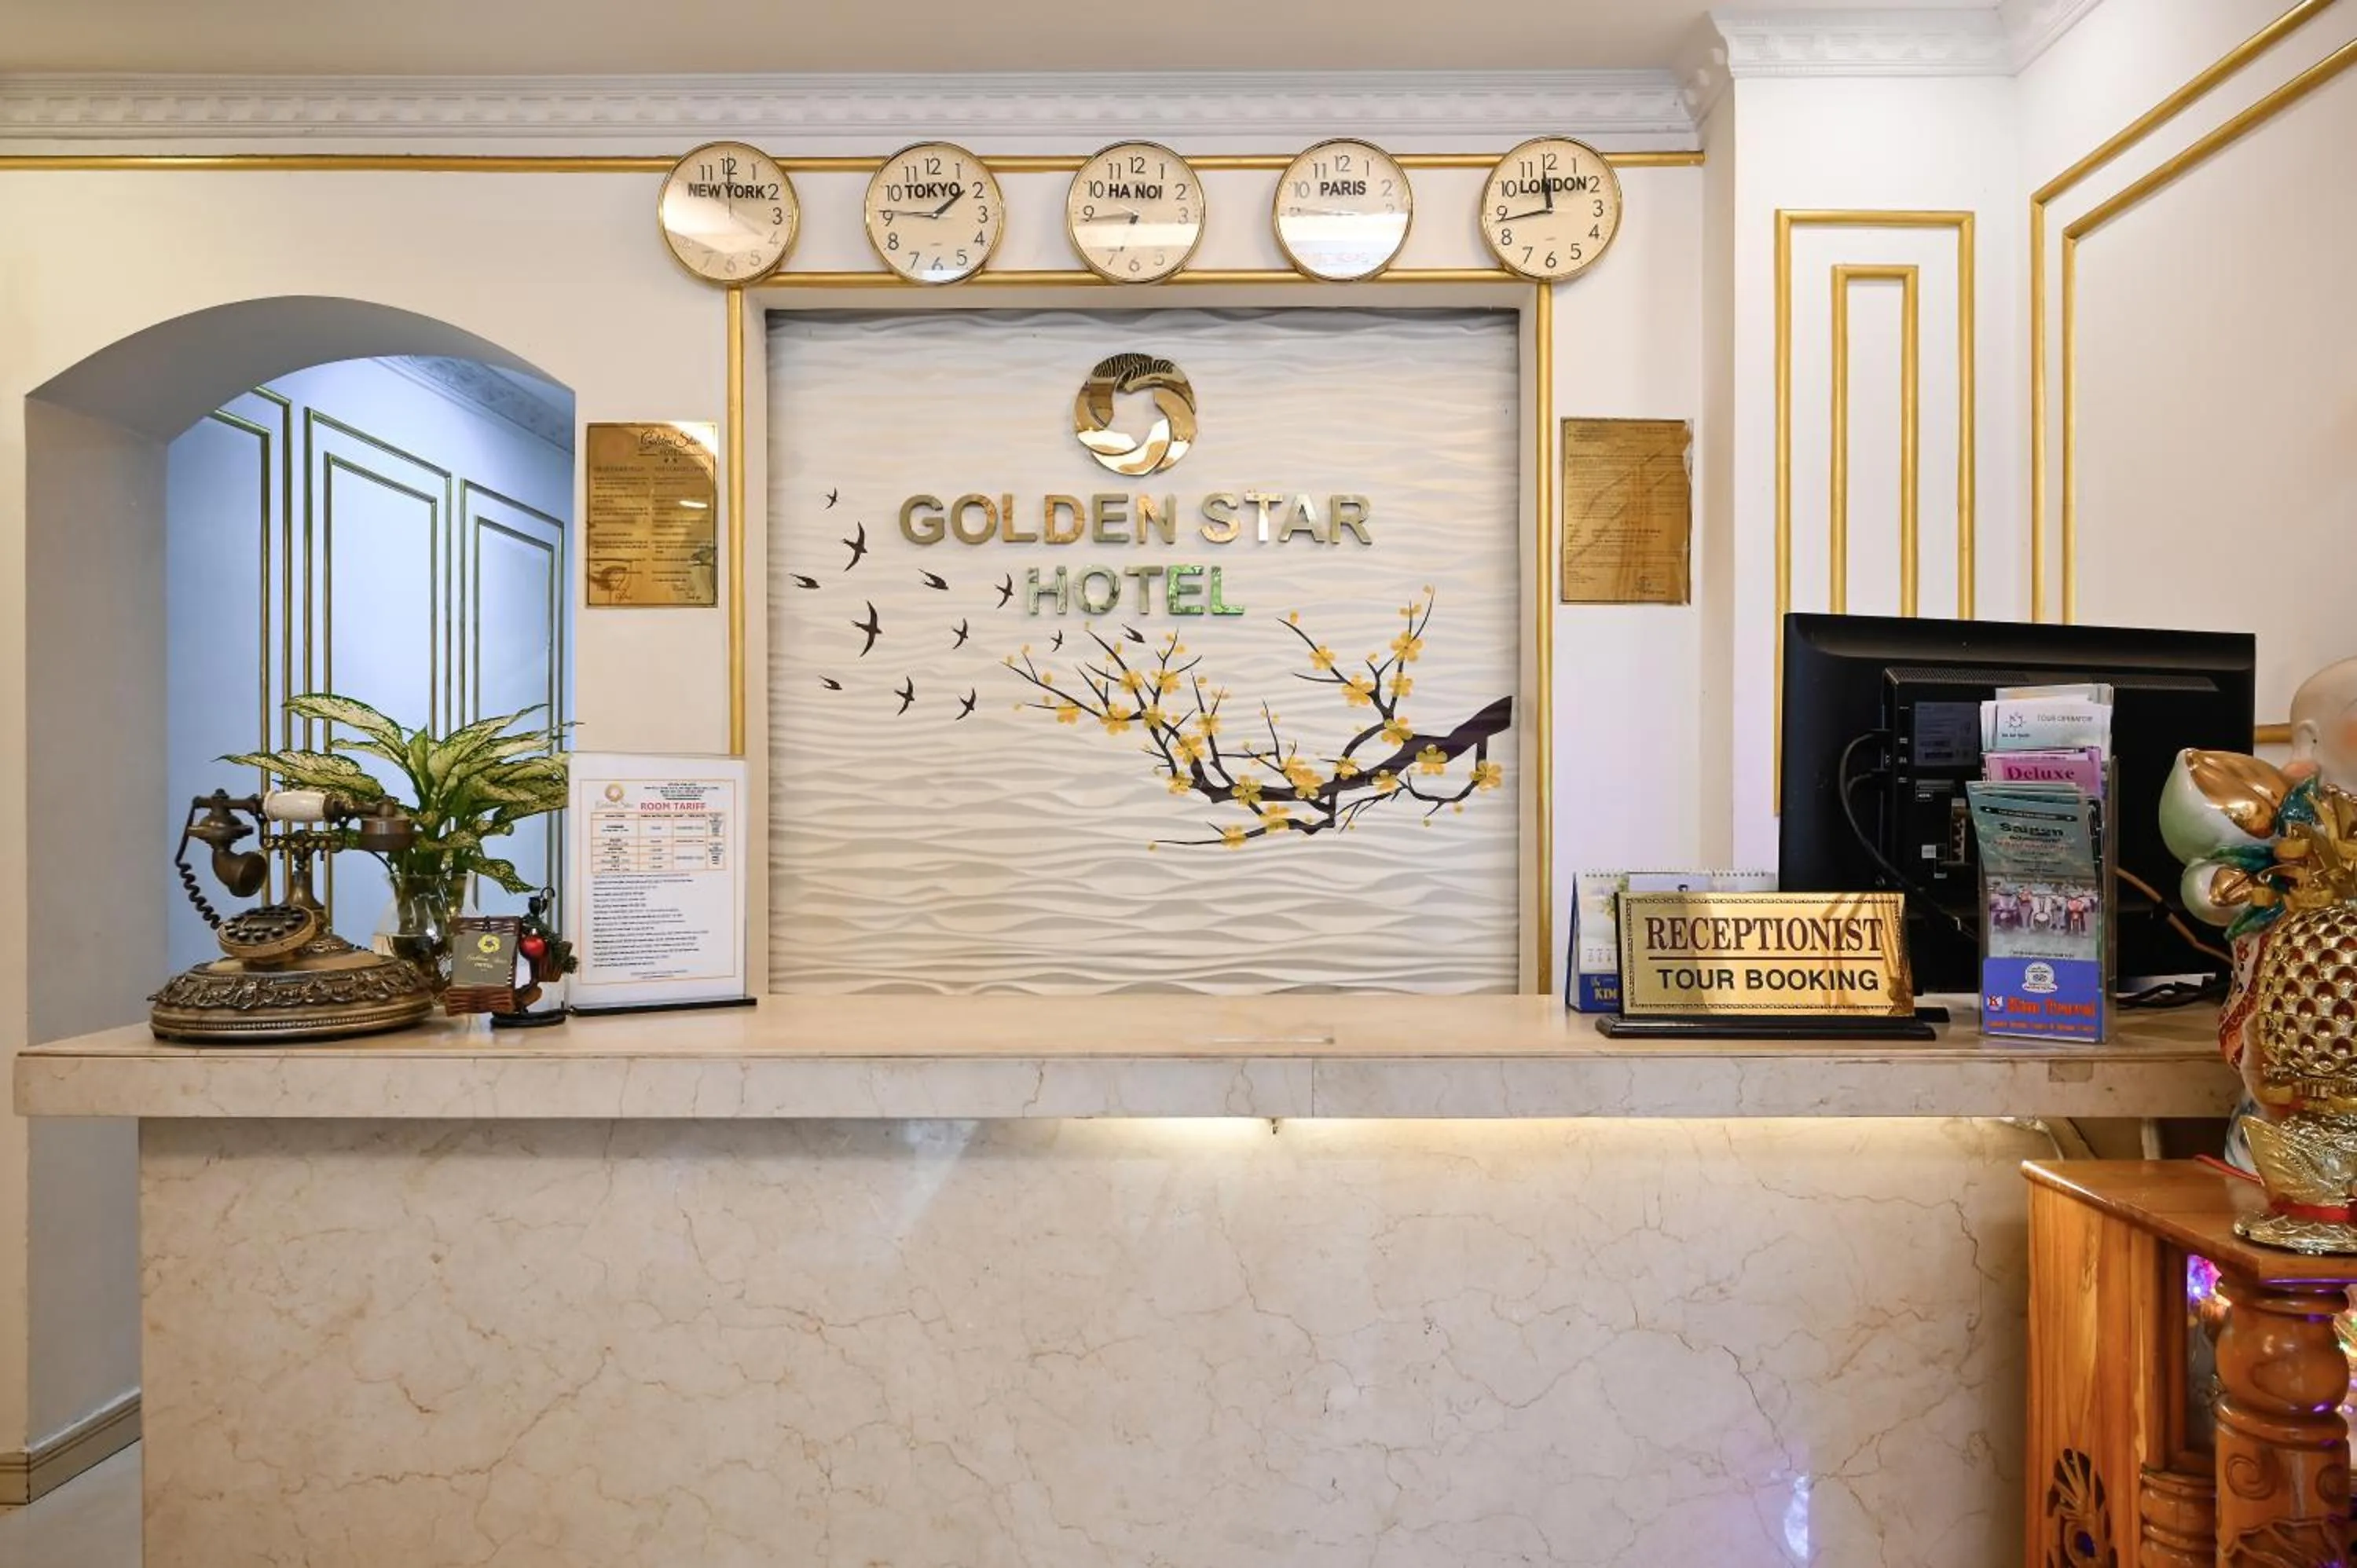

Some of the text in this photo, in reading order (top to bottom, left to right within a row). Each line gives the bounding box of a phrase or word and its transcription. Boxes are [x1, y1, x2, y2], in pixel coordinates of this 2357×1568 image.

[720, 158, 737, 175] 12
[925, 158, 942, 175] 12
[1129, 156, 1146, 174] 12
[1334, 155, 1351, 172] 12
[1365, 159, 1370, 177] 1
[1520, 161, 1533, 178] 11
[1542, 153, 1558, 170] 12
[1571, 158, 1577, 174] 1
[699, 164, 713, 181] 11
[751, 163, 757, 181] 1
[905, 165, 918, 182] 11
[955, 163, 961, 180] 1
[1108, 163, 1121, 180] 11
[1159, 163, 1165, 180] 1
[1314, 163, 1326, 179] 11
[687, 183, 765, 198] NEW YORK
[768, 183, 779, 200] 2
[905, 182, 961, 200] TOKYO
[972, 181, 984, 199] 2
[1088, 181, 1104, 200] 10
[1109, 184, 1163, 200] HA NOI
[1175, 183, 1186, 200] 2
[1293, 181, 1310, 198] 10
[1320, 181, 1367, 196] PARIS
[1381, 179, 1392, 196] 2
[1501, 181, 1517, 197] 10
[1519, 176, 1587, 194] LONDON
[1589, 176, 1600, 193] 2
[886, 185, 902, 202] 10
[772, 207, 783, 225] 3
[978, 206, 988, 224] 3
[1083, 205, 1094, 222] 9
[1178, 207, 1189, 225] 3
[1496, 205, 1508, 222] 9
[1593, 200, 1604, 218] 3
[882, 210, 893, 226] 9
[768, 231, 779, 247] 4
[973, 230, 985, 246] 4
[1501, 228, 1512, 246] 8
[1588, 224, 1600, 239] 4
[888, 233, 899, 251] 8
[750, 249, 761, 266] 5
[909, 251, 920, 269] 7
[956, 249, 967, 266] 5
[1523, 246, 1534, 264] 7
[1545, 251, 1557, 269] 6
[1571, 243, 1582, 260] 5
[931, 256, 944, 271] 6
[899, 490, 1373, 545] GOLDEN STAR
[1027, 564, 1245, 615] HOTEL
[2007, 767, 2075, 781] Deluxe
[640, 801, 707, 811] ROOM TARIFF
[1645, 917, 1883, 951] RECEPTIONIST
[1658, 969, 1879, 991] TOUR BOOKING
